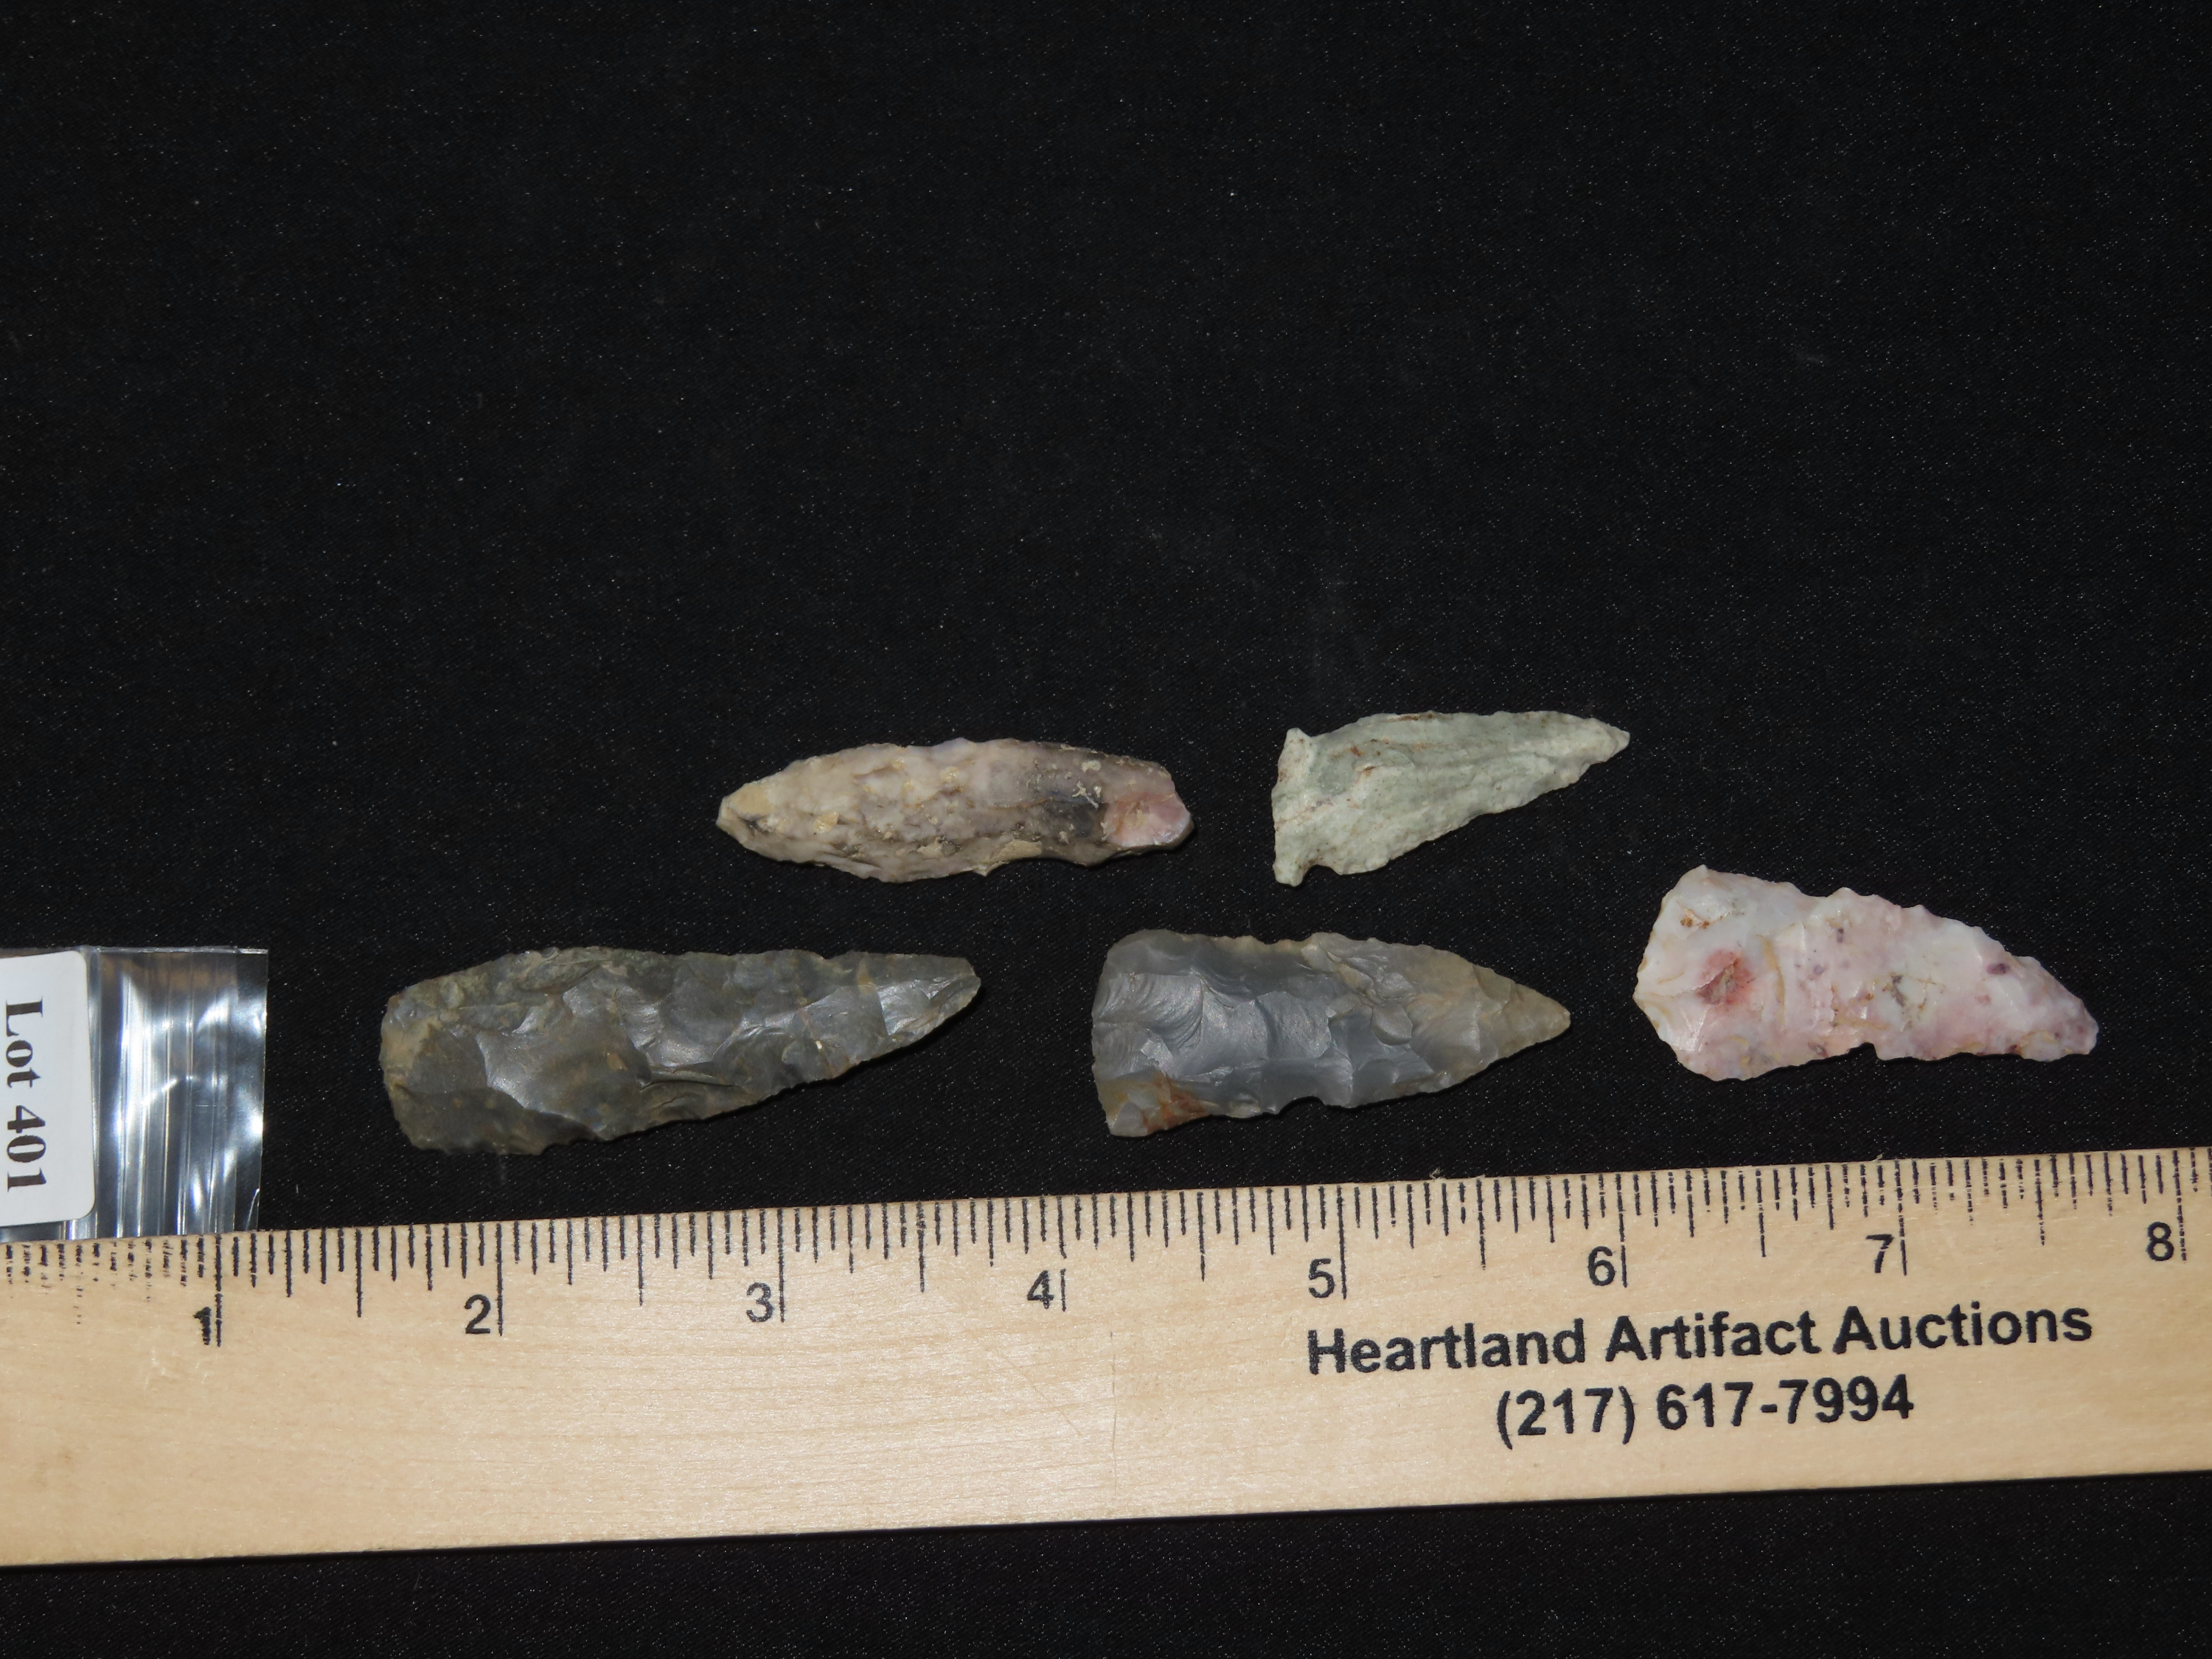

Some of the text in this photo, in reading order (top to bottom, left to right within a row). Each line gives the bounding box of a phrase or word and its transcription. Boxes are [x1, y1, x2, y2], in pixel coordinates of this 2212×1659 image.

[6, 1001, 46, 1190] Lot 401
[1865, 1234, 1895, 1273] 7
[2146, 1221, 2175, 1262] 8
[1308, 1258, 1335, 1298] 5
[1587, 1246, 1616, 1287] 6
[746, 1282, 773, 1323] 3
[1026, 1270, 1054, 1310] 4
[192, 1307, 212, 1346] 1
[464, 1294, 491, 1335] 2
[1307, 1300, 2093, 1376] Heartland Artifact Auctions
[1497, 1374, 1914, 1450] (217) 617-7994
